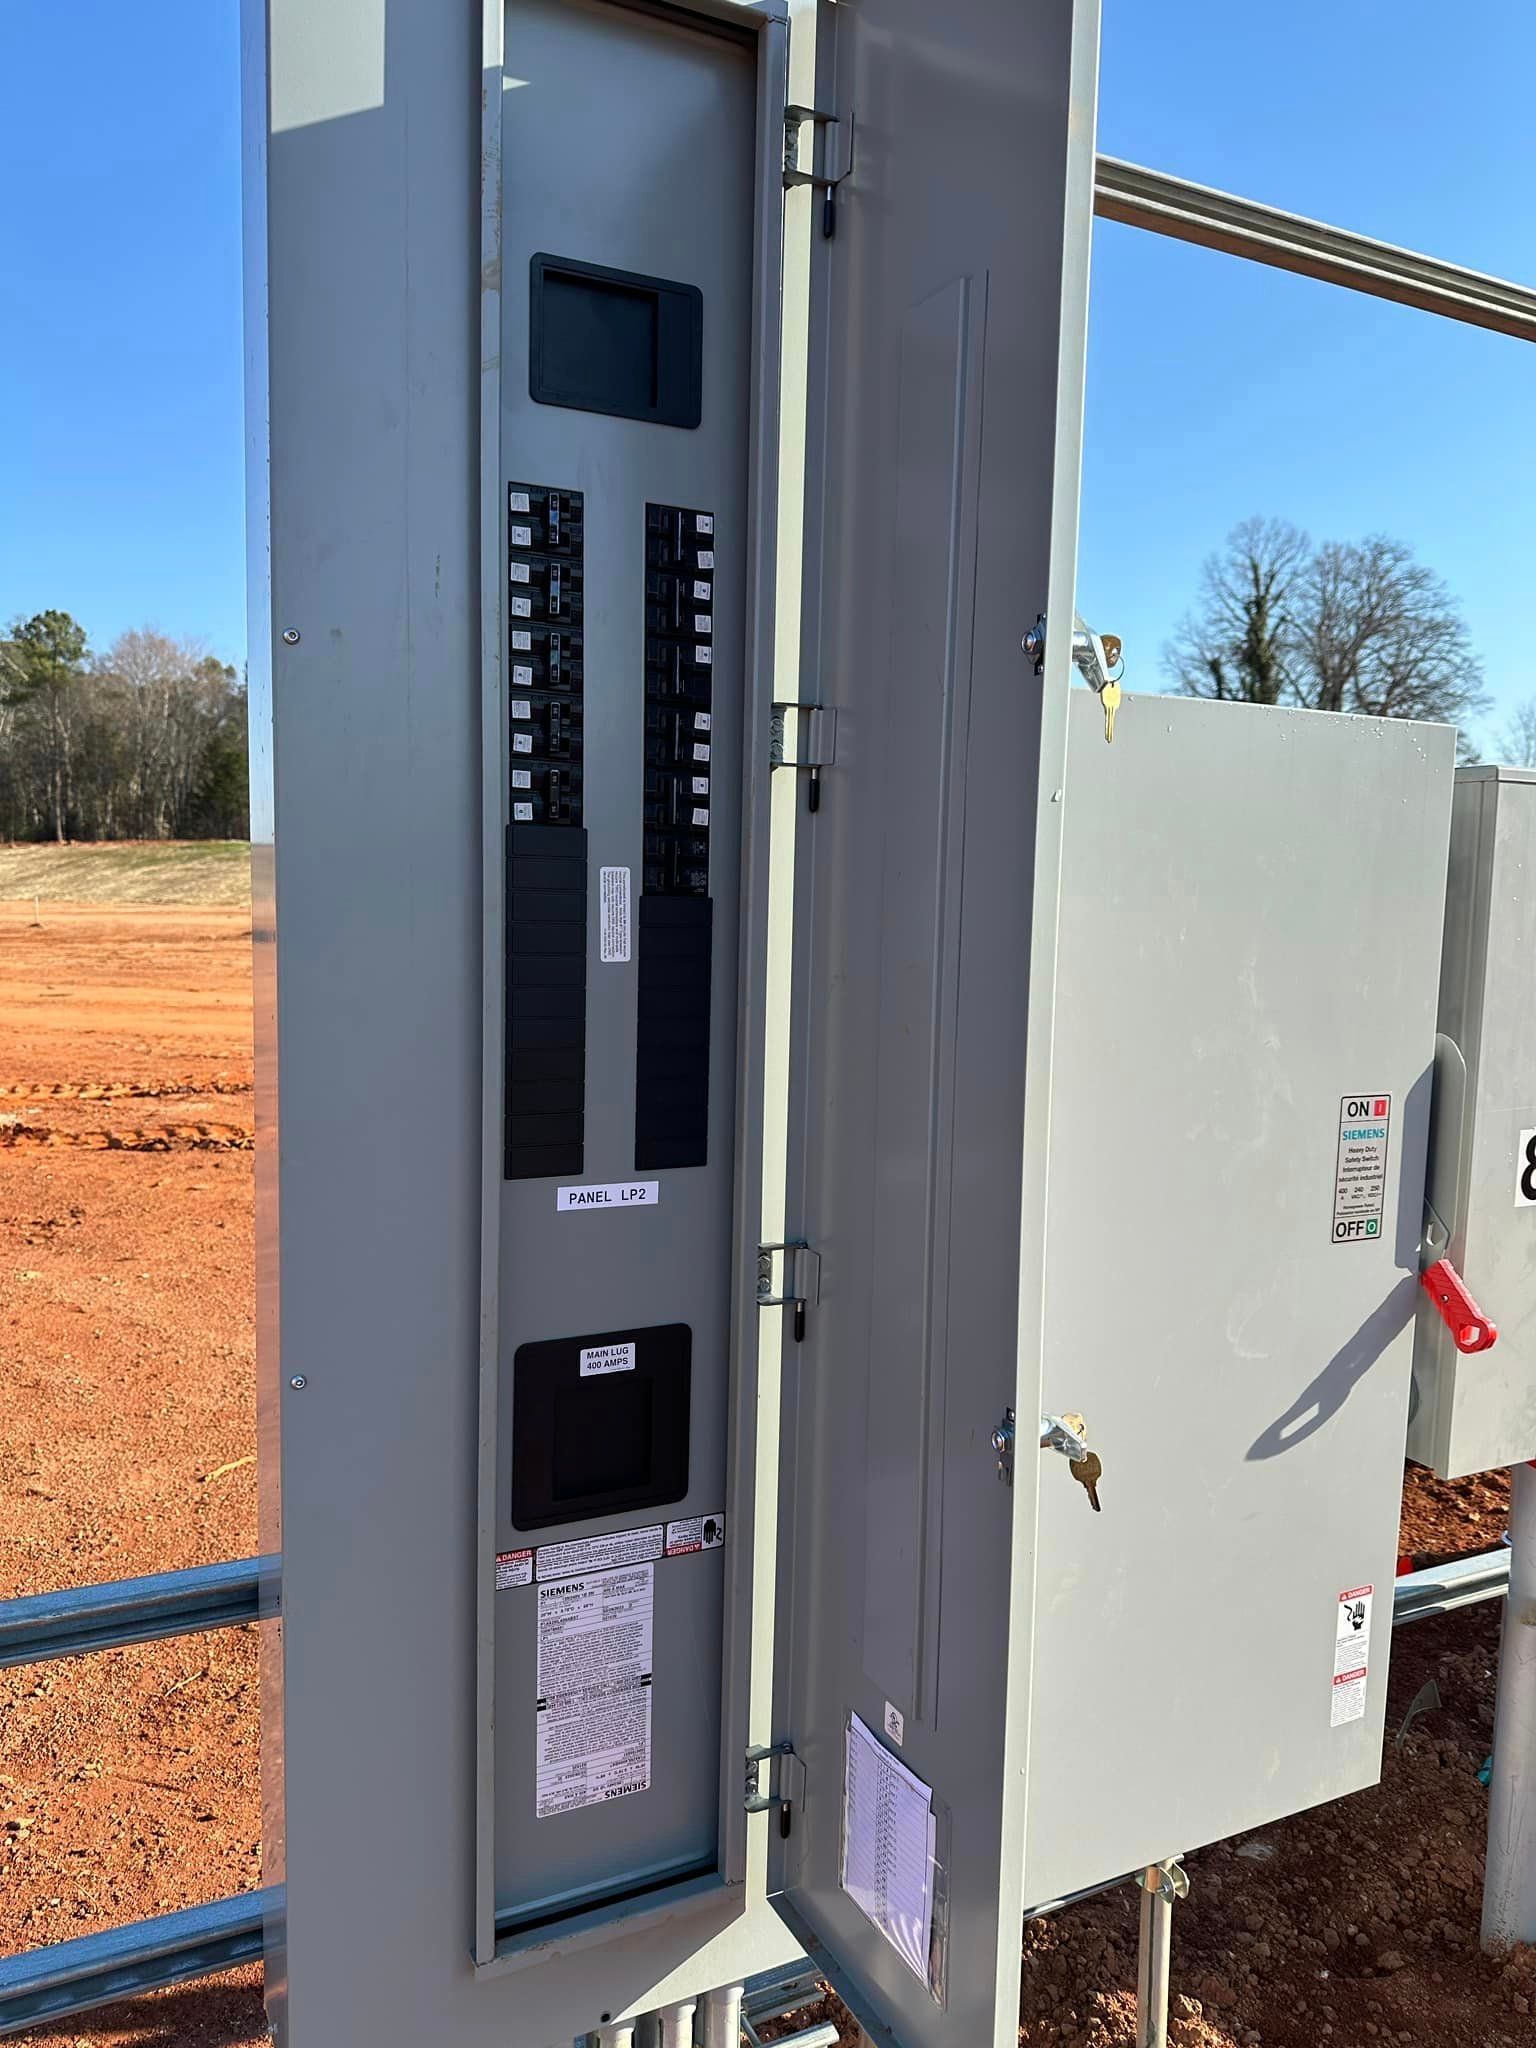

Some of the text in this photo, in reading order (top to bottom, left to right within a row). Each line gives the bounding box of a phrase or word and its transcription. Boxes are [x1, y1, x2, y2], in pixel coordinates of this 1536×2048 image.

[1347, 1101, 1370, 1117] ON
[1342, 1128, 1385, 1141] SIEMENS
[569, 1188, 646, 1204] PANEL LP2
[1335, 1220, 1365, 1238] OFF
[586, 1346, 629, 1359] MAIN LUG
[587, 1361, 602, 1369] 400
[603, 1357, 629, 1368] AMPS
[502, 1550, 532, 1560] DANGER
[667, 1545, 694, 1556] DANGER
[540, 1582, 585, 1598] SIEMENS
[1347, 1587, 1371, 1599] DANGER
[1342, 1669, 1365, 1682] DANGER
[604, 1780, 647, 1799] SIEMENS
